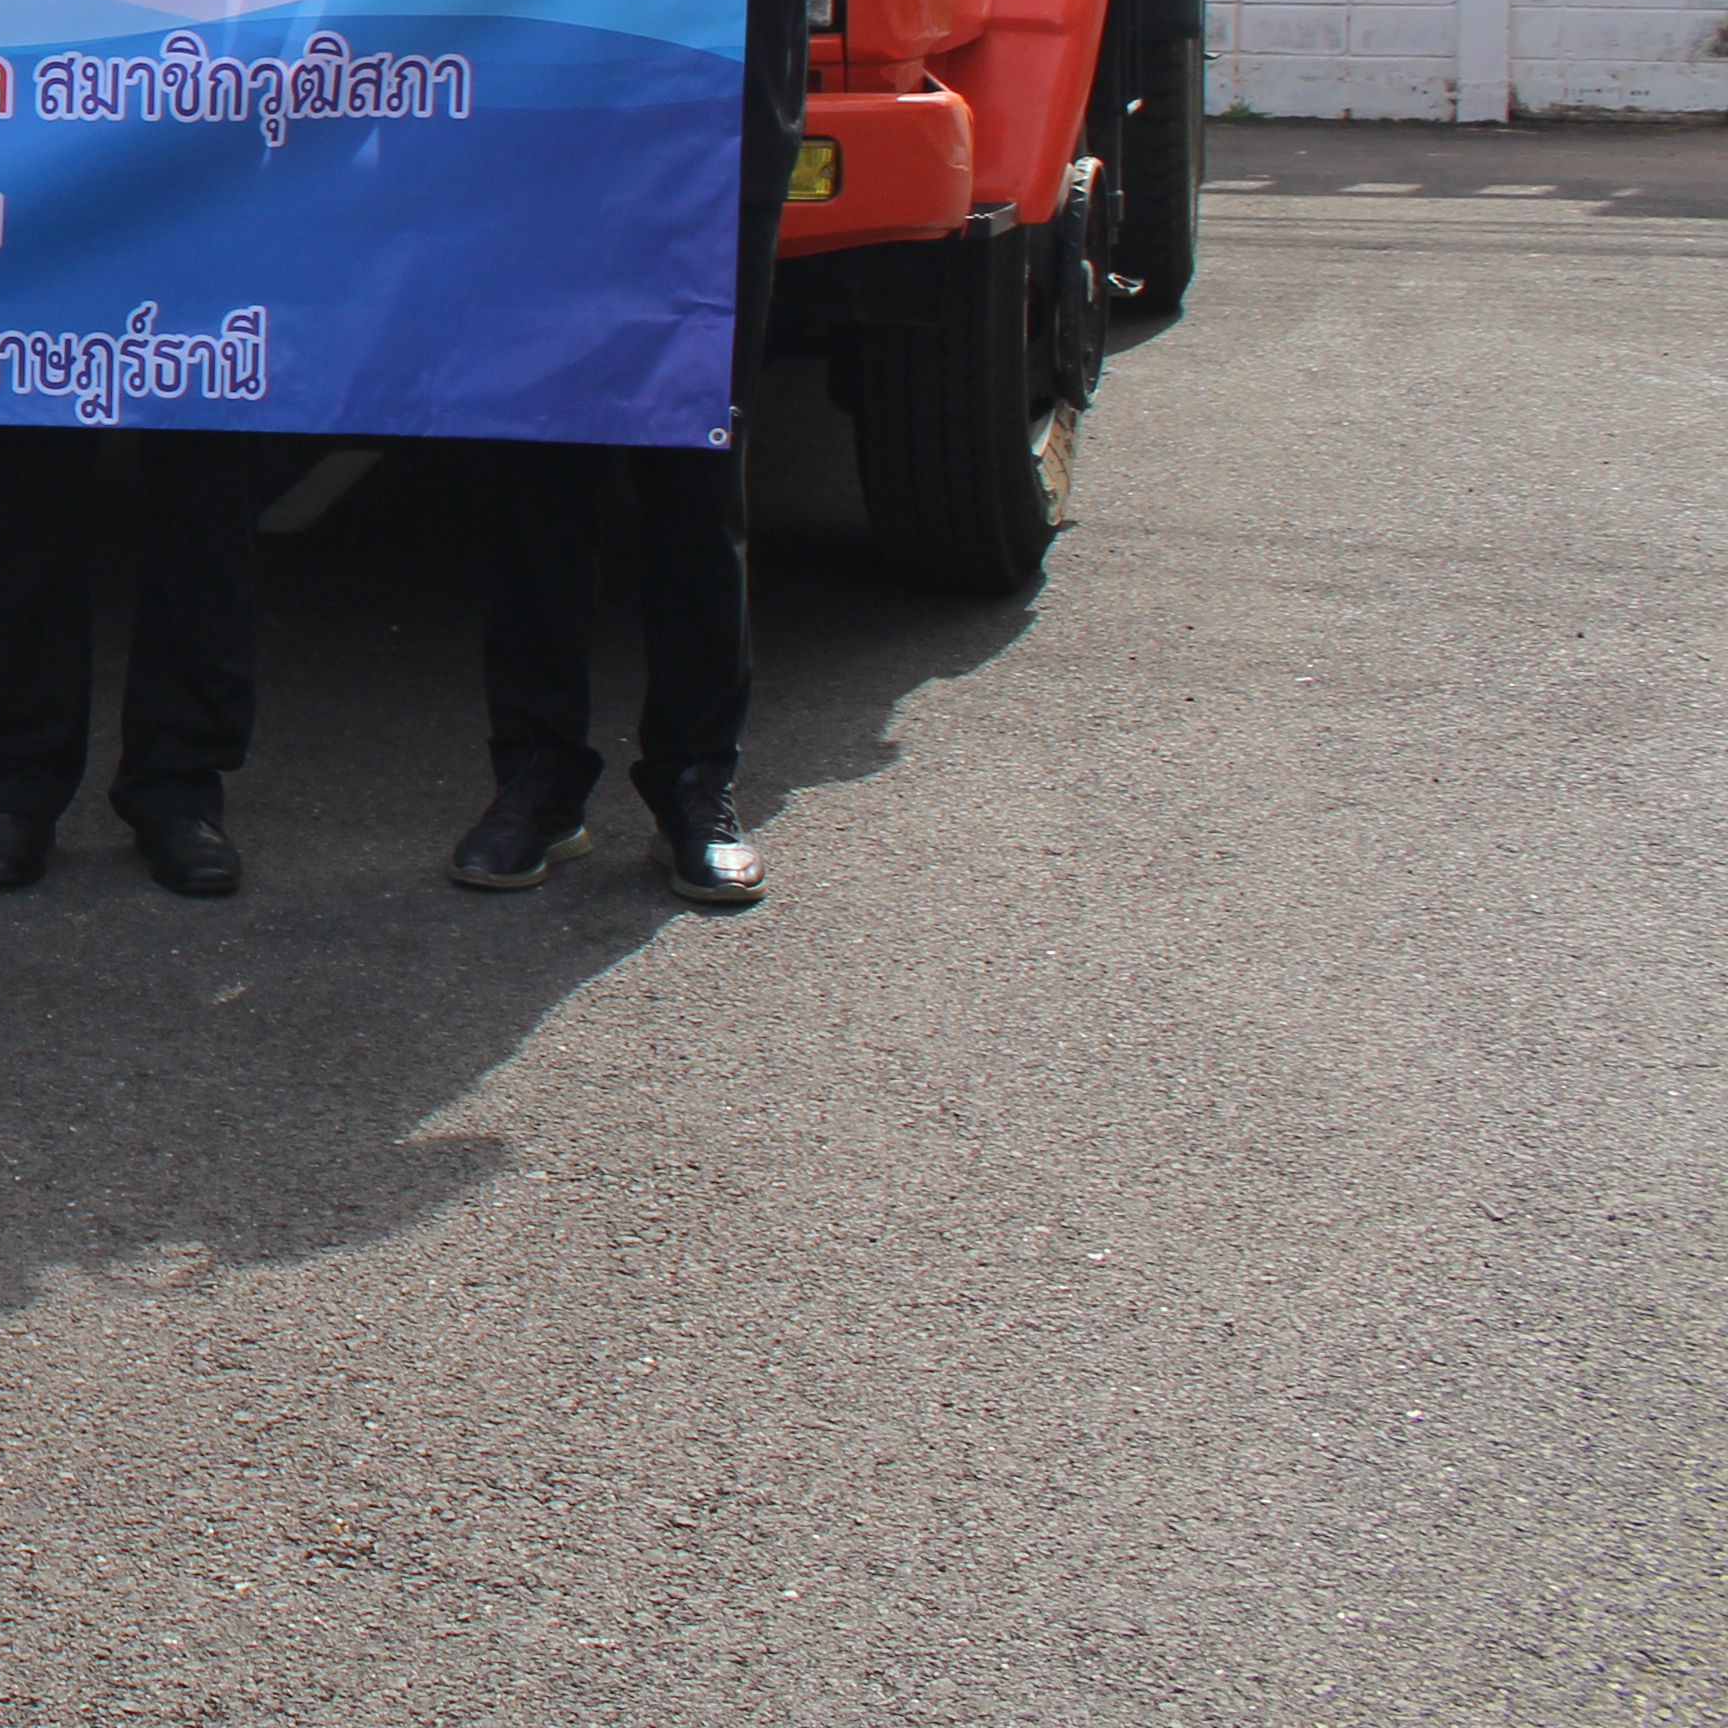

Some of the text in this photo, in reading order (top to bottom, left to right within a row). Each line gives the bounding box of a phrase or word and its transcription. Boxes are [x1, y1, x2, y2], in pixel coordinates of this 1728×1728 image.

[38, 34, 467, 143] สมาชิกวุฒิสภา
